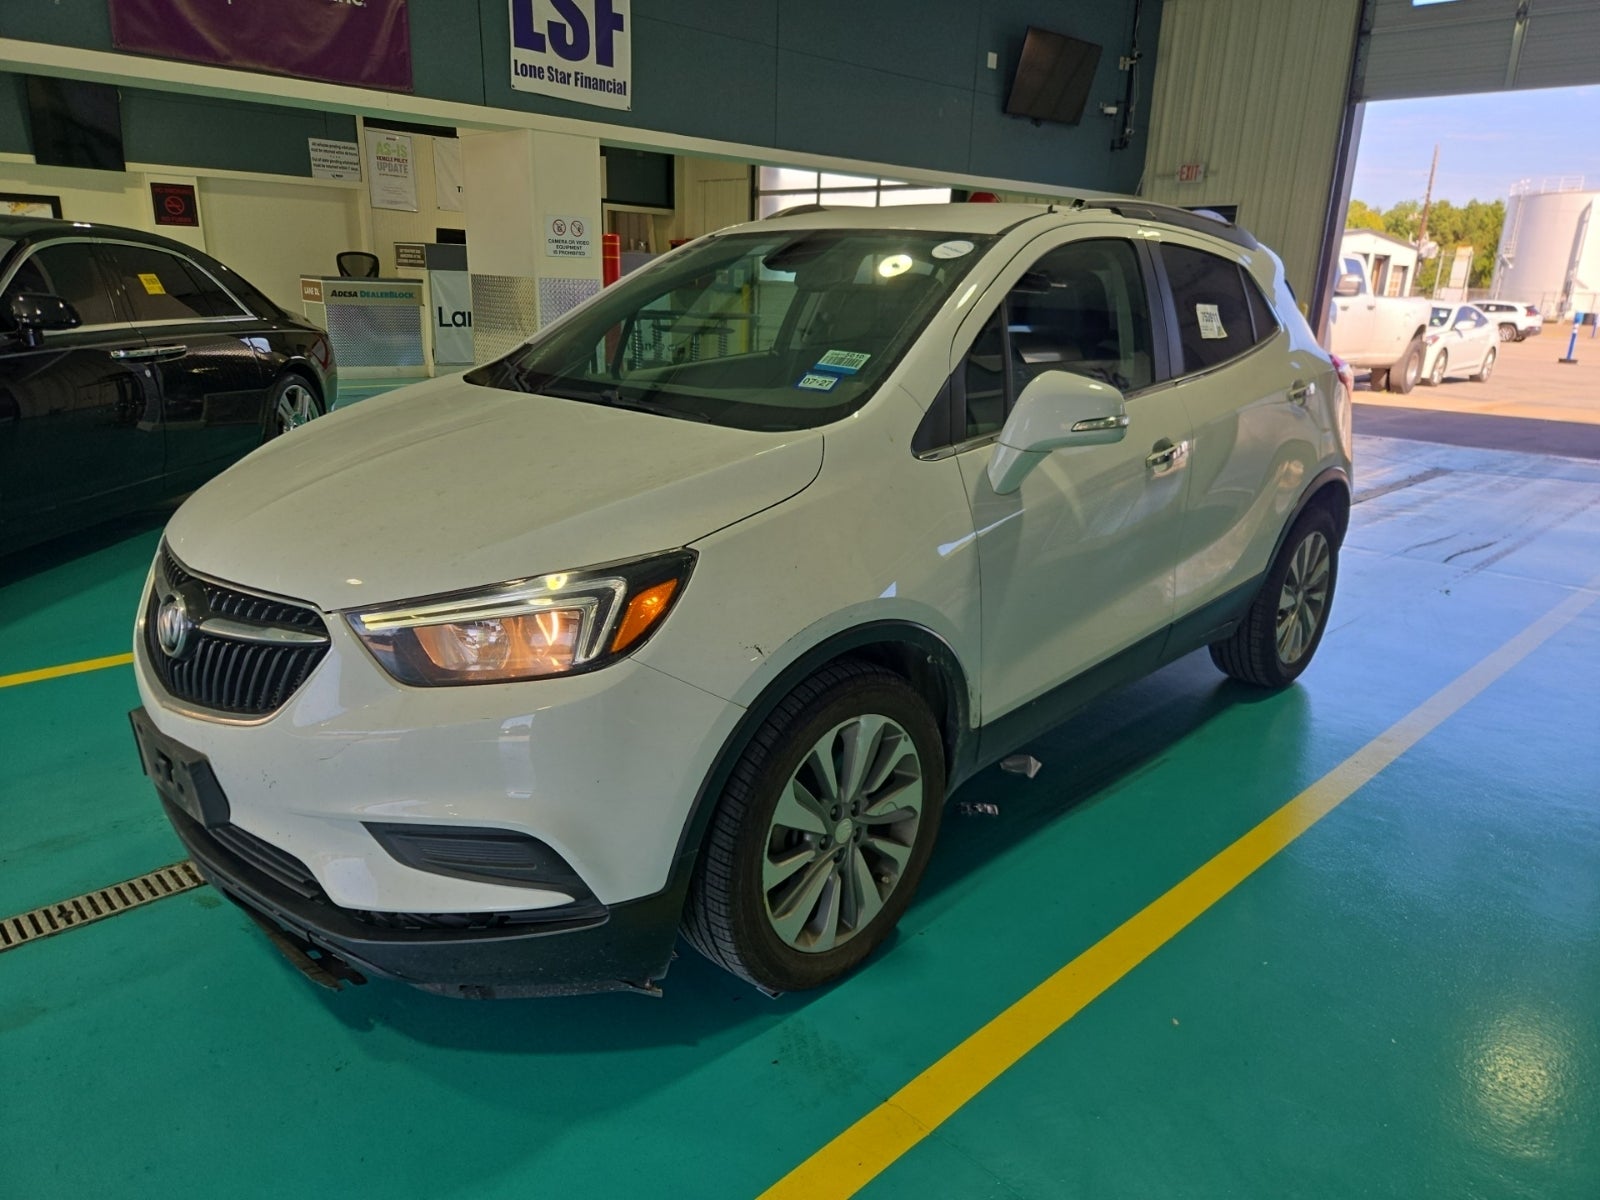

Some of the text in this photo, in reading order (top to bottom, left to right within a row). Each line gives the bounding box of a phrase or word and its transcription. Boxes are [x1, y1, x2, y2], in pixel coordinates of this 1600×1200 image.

[512, 0, 625, 68] LSF
[513, 59, 627, 96] Lone Star Financial
[376, 141, 408, 157] AS-IS
[376, 161, 408, 174] UPDATE
[1179, 164, 1200, 181] EXIT
[331, 289, 358, 298] ADESA
